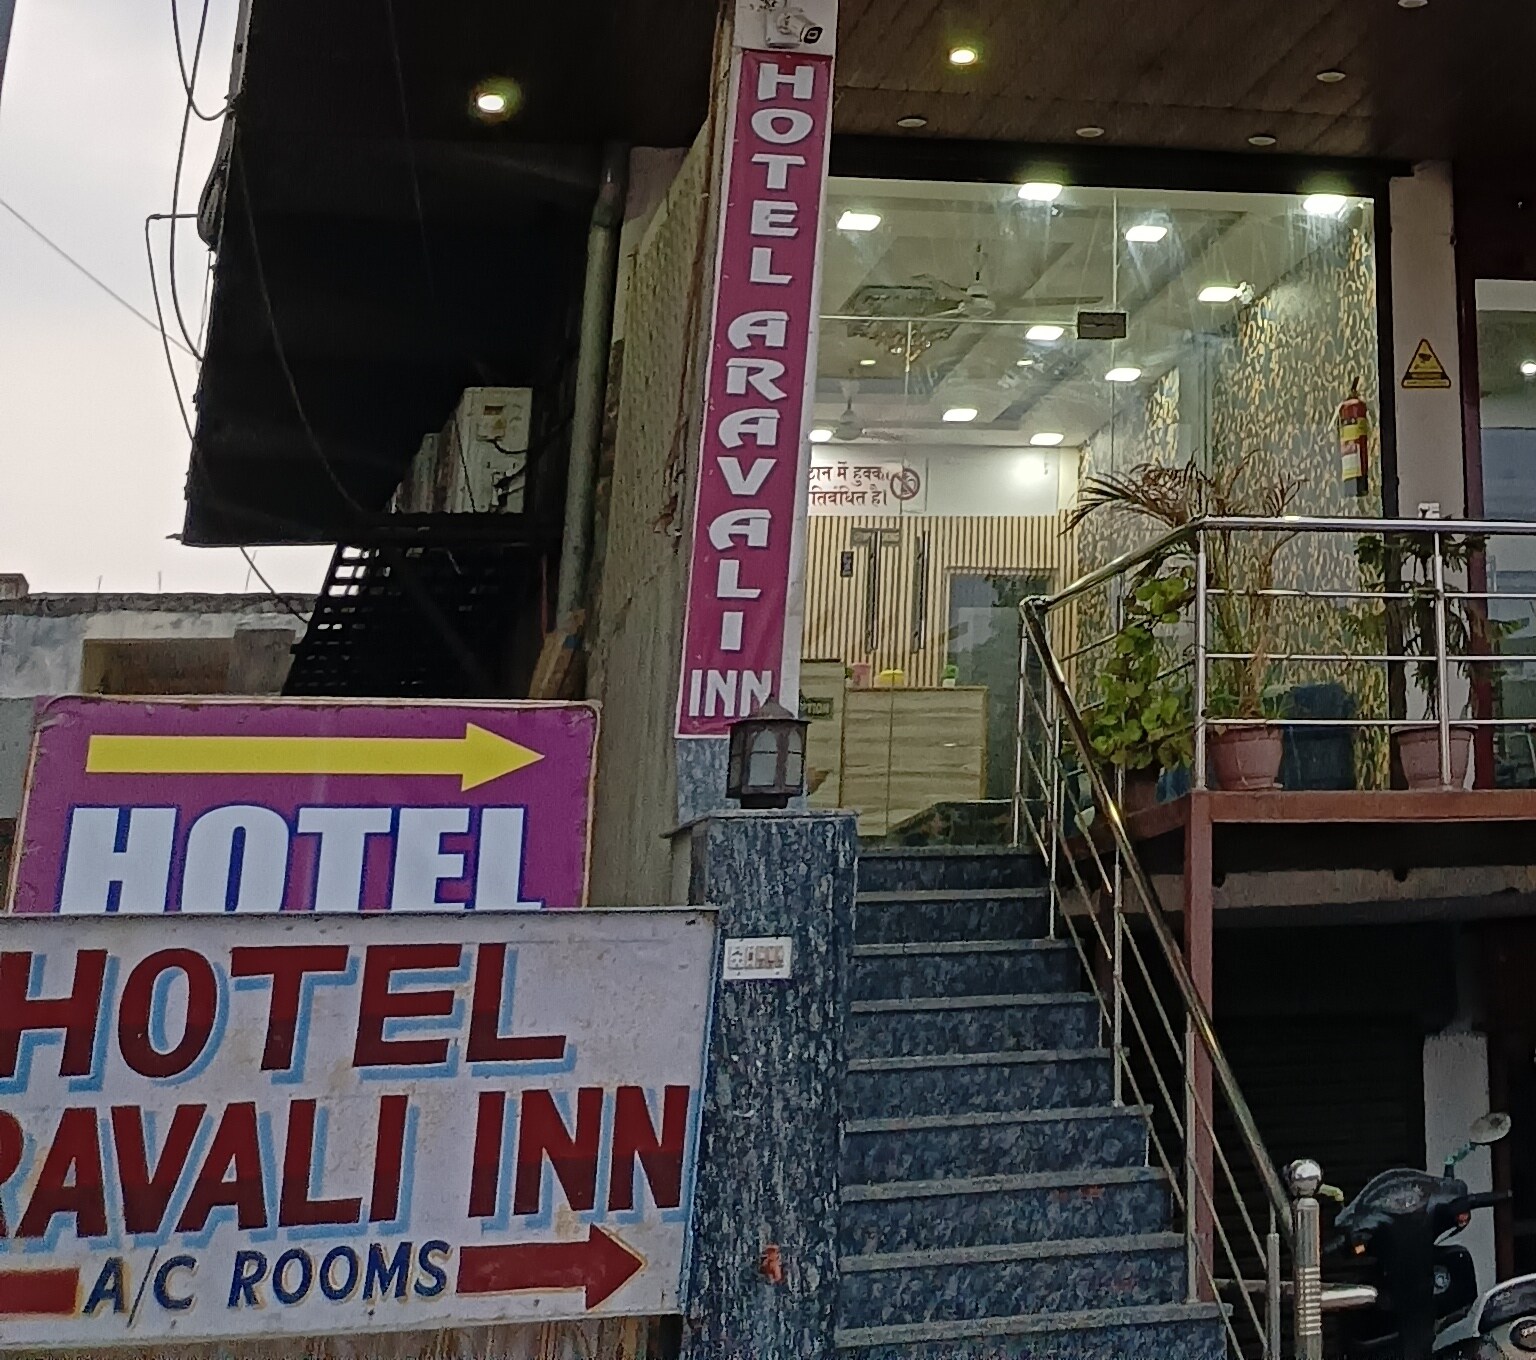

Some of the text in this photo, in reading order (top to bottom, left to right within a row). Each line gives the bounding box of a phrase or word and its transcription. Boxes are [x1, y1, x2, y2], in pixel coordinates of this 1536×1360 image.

[708, 63, 815, 651] HOTEL ARAVALI
[689, 669, 773, 717] INN
[58, 803, 546, 913] HOTEL
[0, 942, 568, 1080] HOTEL
[468, 1084, 692, 1218] INN
[82, 1238, 452, 1328] A/C ROOMS
